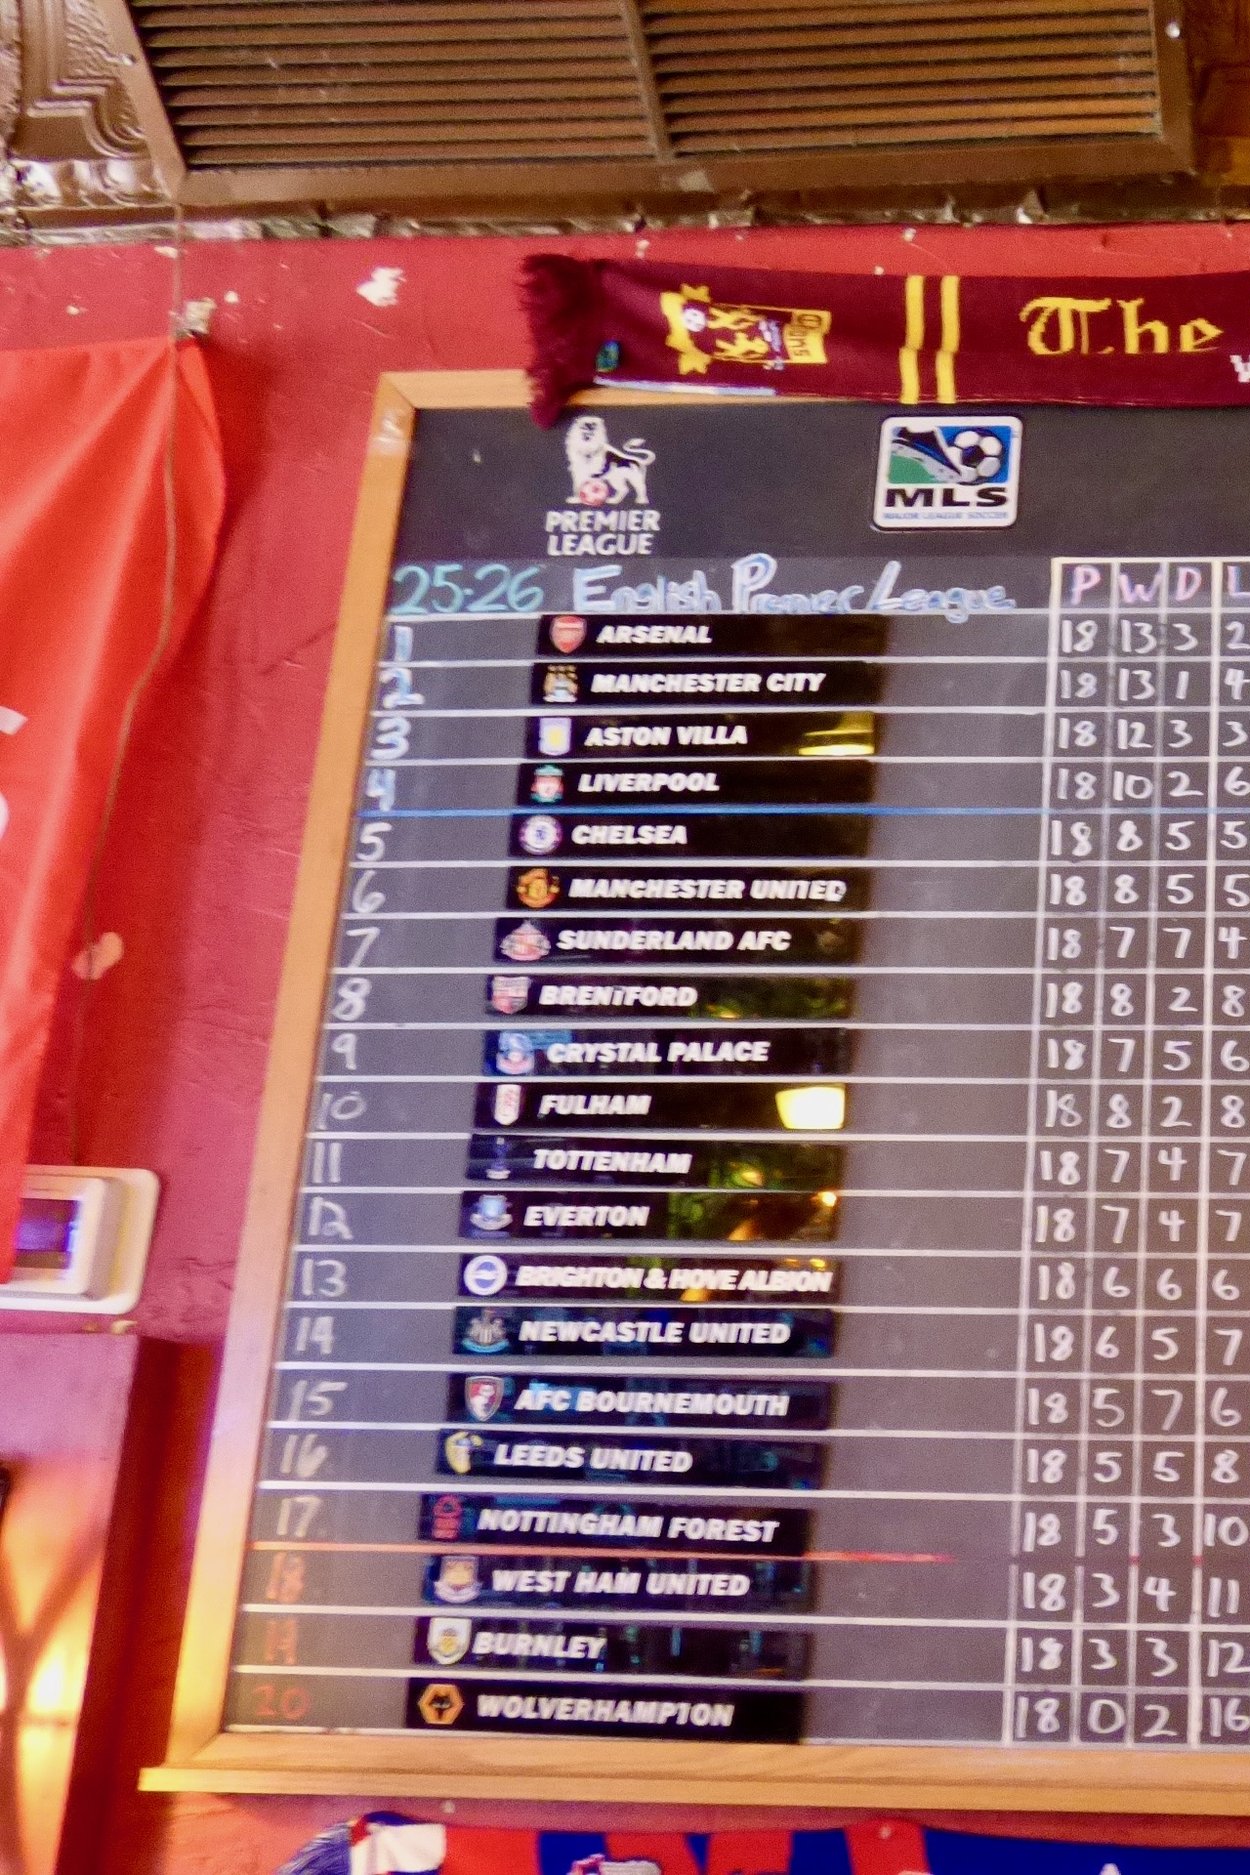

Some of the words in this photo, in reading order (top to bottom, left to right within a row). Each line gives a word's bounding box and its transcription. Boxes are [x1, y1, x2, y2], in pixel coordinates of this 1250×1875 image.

[1019, 296, 1224, 356] The
[884, 487, 1008, 508] MLS
[545, 509, 660, 534] PREMIER
[547, 532, 653, 557] LEAGUE
[573, 564, 720, 614] English
[865, 560, 1017, 624] League
[1070, 565, 1101, 605] P
[1118, 573, 1163, 602] W
[1176, 566, 1201, 600] D
[395, 627, 414, 663] 1
[597, 625, 711, 645] ARSENAL
[1062, 619, 1099, 653] 18
[1120, 621, 1156, 655] 13
[1172, 622, 1199, 652] 3
[379, 670, 424, 708] 2
[591, 672, 761, 693] MANCHESTER
[765, 672, 826, 693] CITY
[371, 718, 411, 760] 3
[585, 726, 671, 747] ASTON
[675, 725, 747, 746] VILLA
[366, 768, 396, 811] 4
[578, 773, 719, 793] LIVERPOOL
[358, 823, 392, 862] 5
[571, 825, 687, 846] CHELSEA
[353, 870, 387, 916] 6
[568, 879, 745, 900] MANCHESTER
[345, 927, 380, 969] 7
[556, 930, 733, 952] SUNDERLAND
[737, 930, 792, 952] AFC
[333, 977, 373, 1020] 8
[333, 1034, 358, 1070] 9
[545, 1042, 661, 1064] CRYSTAL
[667, 1041, 771, 1063] PALACE
[539, 1095, 652, 1117] FULHAM
[313, 1142, 342, 1184] 11
[533, 1150, 693, 1174] TOTTENHAM
[524, 1206, 649, 1228] EVERTON
[302, 1259, 346, 1297] 13
[516, 1266, 643, 1289] BRIGHTON
[644, 1268, 667, 1291] &
[670, 1269, 739, 1292] HOVE
[740, 1271, 832, 1293] ALBION
[295, 1316, 335, 1355] 14
[519, 1321, 685, 1344] NEWCASTLE
[688, 1323, 790, 1345] UNITED
[287, 1381, 347, 1421] 15
[515, 1389, 571, 1411] AFC
[575, 1391, 790, 1417] BOURNEMOUTH
[494, 1444, 585, 1468] LEEDS
[590, 1447, 693, 1473] UNITED
[277, 1496, 322, 1538] 17
[478, 1509, 662, 1538] NOTTINGHAM
[668, 1517, 779, 1543] FOREST
[492, 1569, 571, 1593] WEST
[574, 1571, 642, 1595] HAM
[646, 1573, 751, 1597] UNITED
[472, 1633, 608, 1660] BURNLEY
[1016, 1696, 1060, 1738] 18
[1087, 1699, 1126, 1734] 0
[1143, 1704, 1179, 1738] 2
